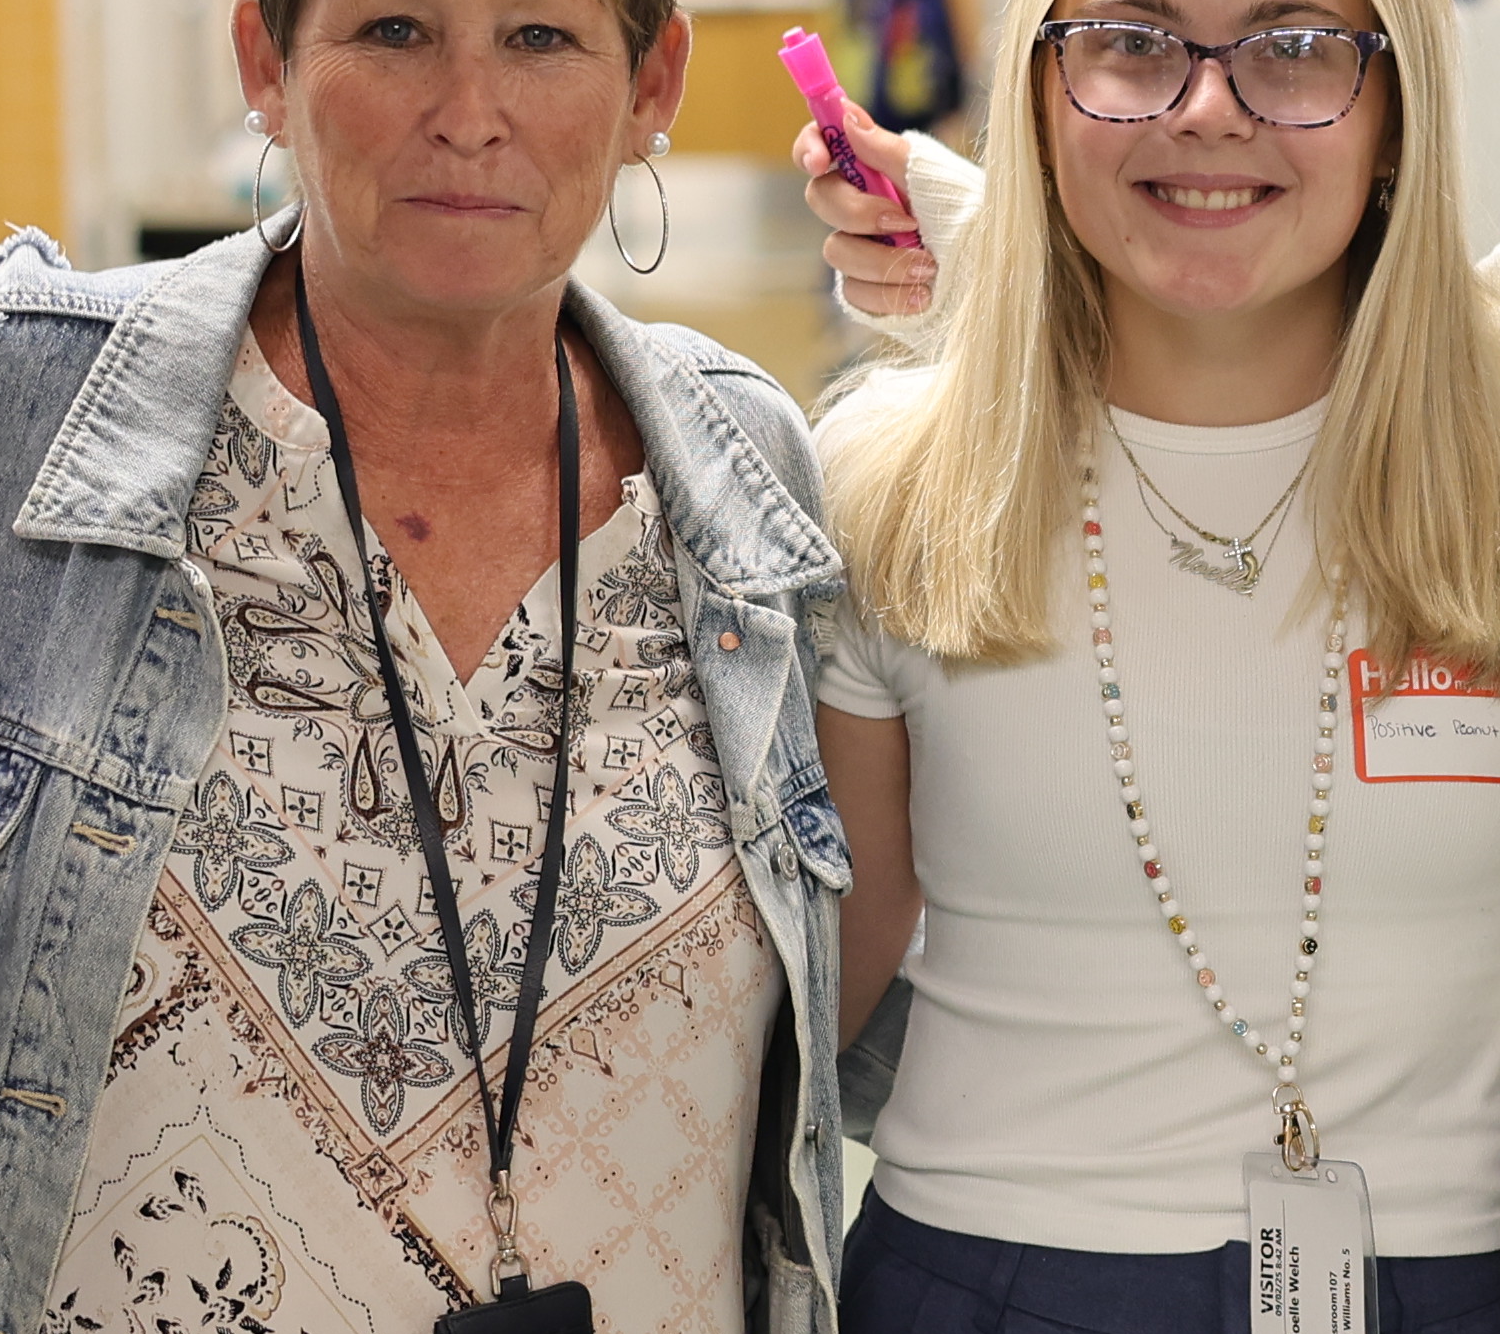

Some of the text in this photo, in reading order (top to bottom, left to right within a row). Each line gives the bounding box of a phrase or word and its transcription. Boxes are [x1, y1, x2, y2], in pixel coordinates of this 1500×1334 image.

[1452, 719, 1500, 738] Peanut
[1275, 1228, 1282, 1245] AM
[1342, 1248, 1350, 1256] 5
[1260, 1227, 1275, 1315] VISITOR
[1289, 1246, 1300, 1294] Welch
[1342, 1259, 1351, 1279] No.
[1275, 1271, 1283, 1317] 09/02/25
[1342, 1283, 1351, 1331] Williams
